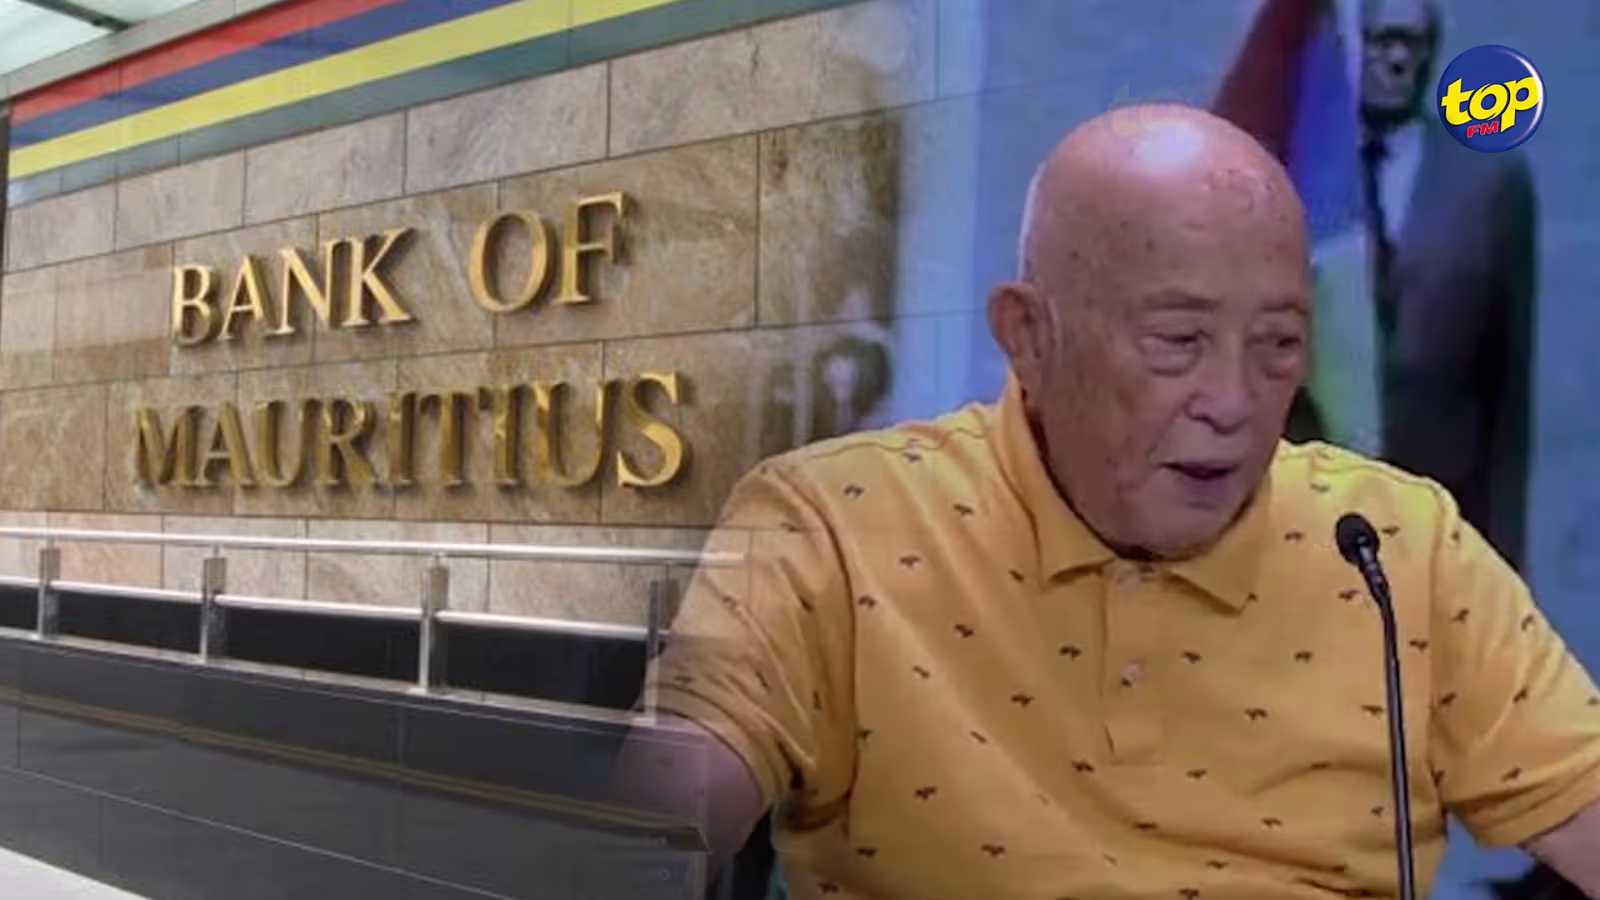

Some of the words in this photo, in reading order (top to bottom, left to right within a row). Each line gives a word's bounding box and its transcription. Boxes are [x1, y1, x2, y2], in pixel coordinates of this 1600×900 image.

[171, 227, 414, 347] BANK
[467, 190, 634, 314] OF
[134, 370, 690, 490] MAURITIUS
